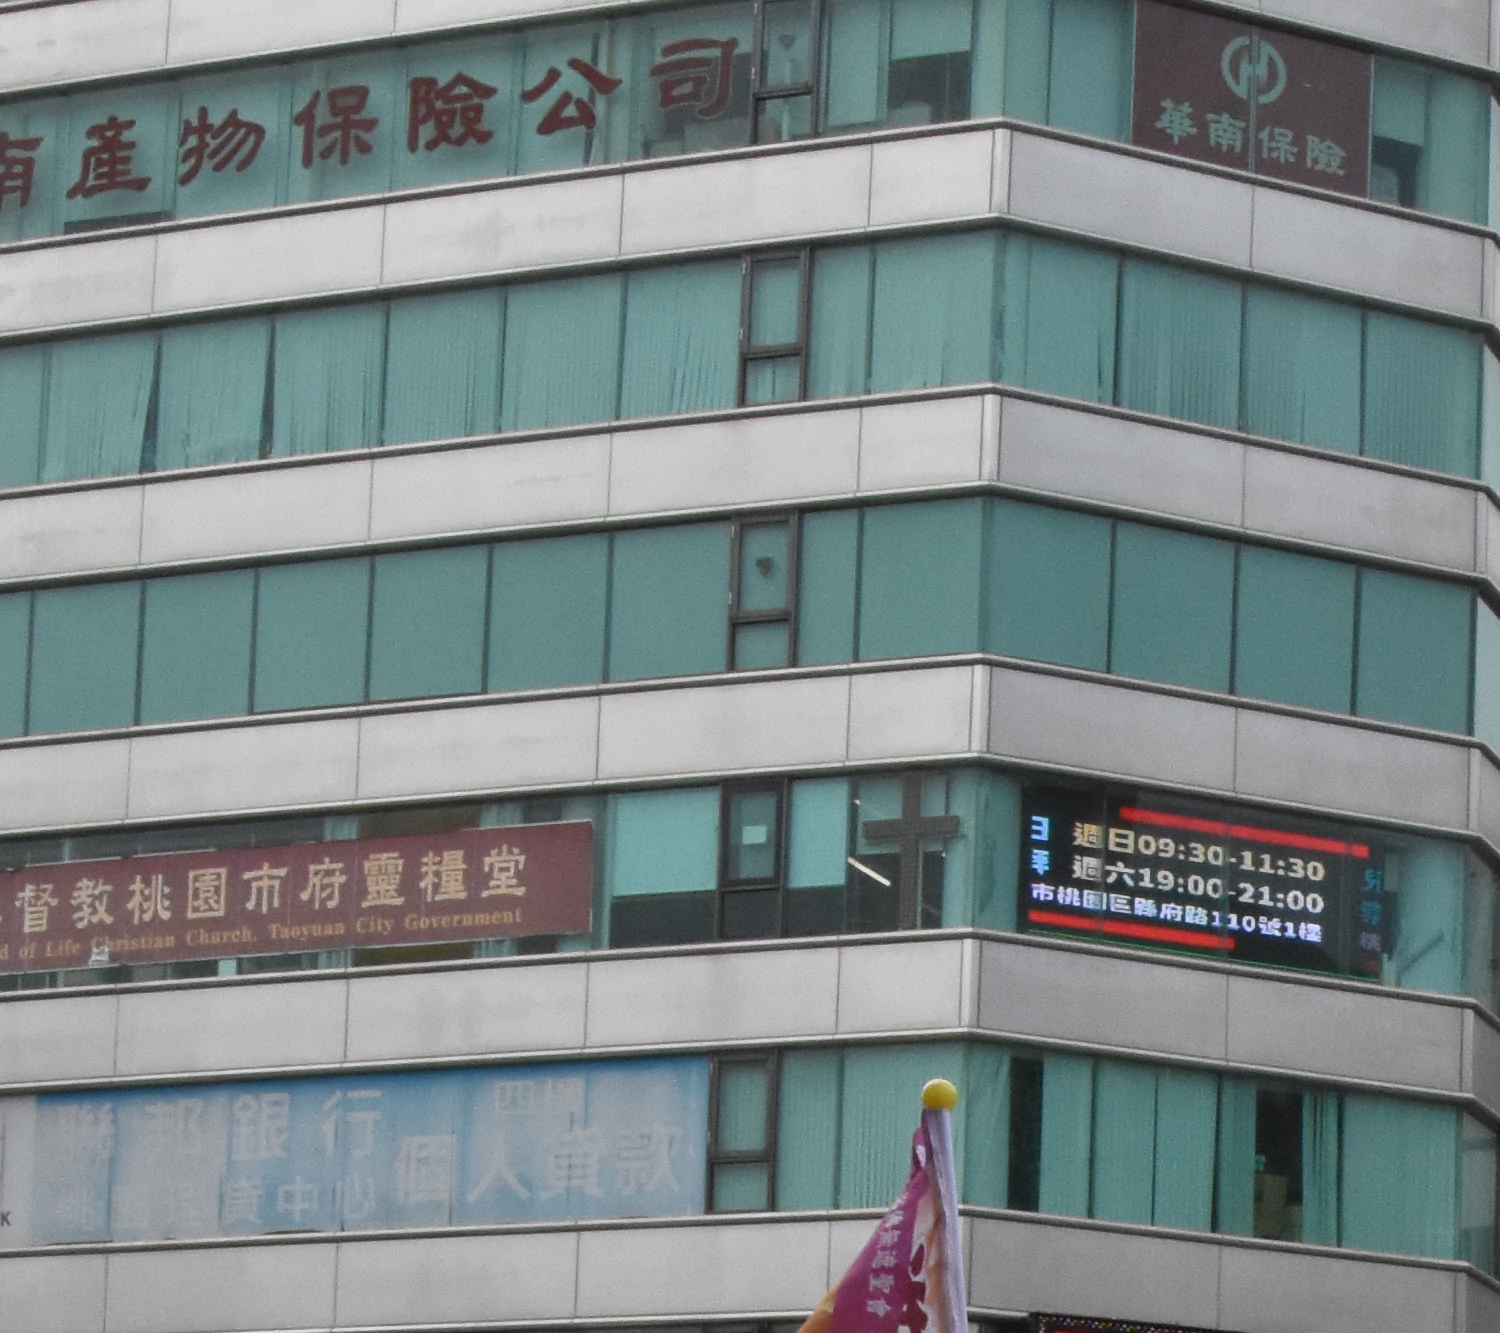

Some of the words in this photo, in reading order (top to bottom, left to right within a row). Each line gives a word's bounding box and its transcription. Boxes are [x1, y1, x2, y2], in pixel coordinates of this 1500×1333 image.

[1152, 99, 1347, 178] 華南保險
[19, 942, 36, 960] of
[44, 938, 81, 959] Life
[269, 920, 346, 943] Taoyuan
[355, 914, 395, 936] City
[405, 908, 524, 932] Government
